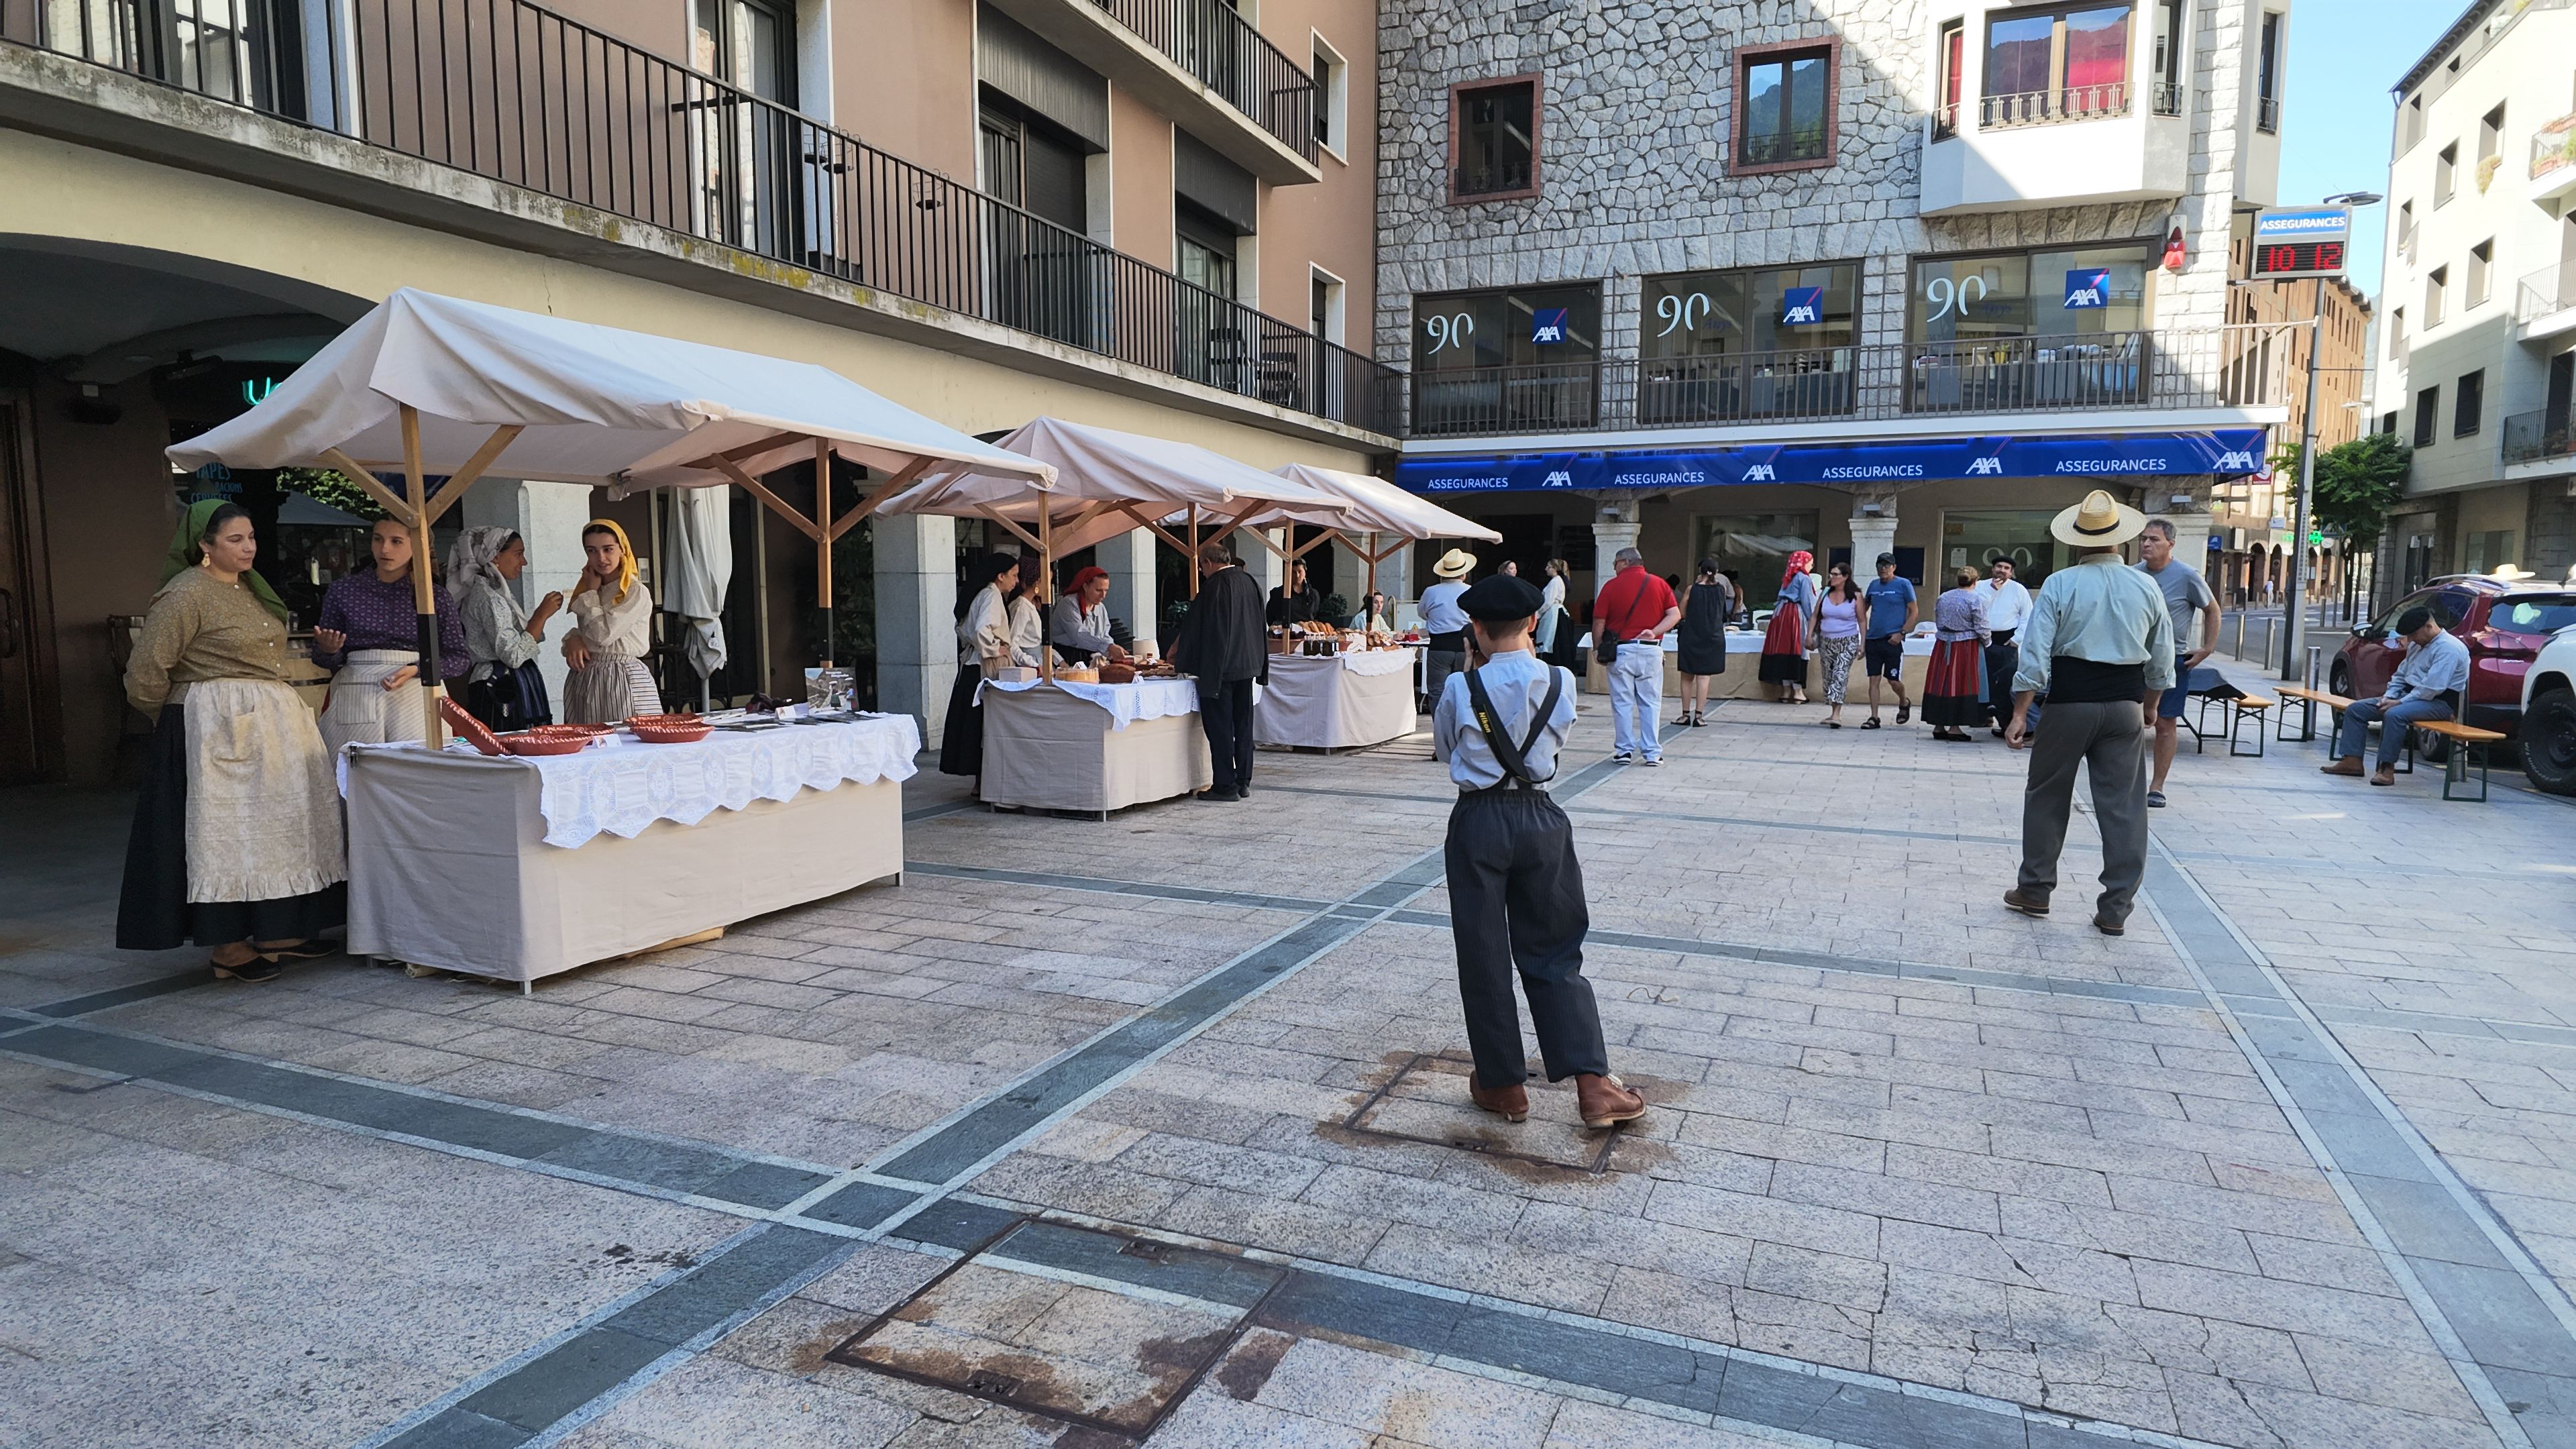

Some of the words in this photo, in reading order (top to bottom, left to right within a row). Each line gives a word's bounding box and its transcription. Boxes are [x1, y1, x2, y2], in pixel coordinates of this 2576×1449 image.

[2260, 217, 2345, 229] ASSEGURANCES
[2267, 246, 2296, 272] 10
[2314, 244, 2342, 270] 12
[1927, 275, 1986, 322] 90
[2064, 288, 2100, 306] AXA
[1654, 292, 1710, 337] 90
[1783, 306, 1815, 323] AXA
[1427, 313, 1474, 355] 90
[1532, 326, 1560, 342] AXA
[1966, 457, 2002, 474] AXA
[2055, 458, 2166, 472] ASSEGURANCES
[2213, 451, 2255, 469] AXA
[1542, 471, 1572, 486] AXA
[1614, 471, 1705, 484] ASSEGURANCES
[1741, 464, 1776, 481] AXA
[1822, 464, 1923, 478] ASSEGURANCES
[1428, 477, 1508, 489] ASSEGURANCES
[1478, 712, 1491, 733] Nikon
